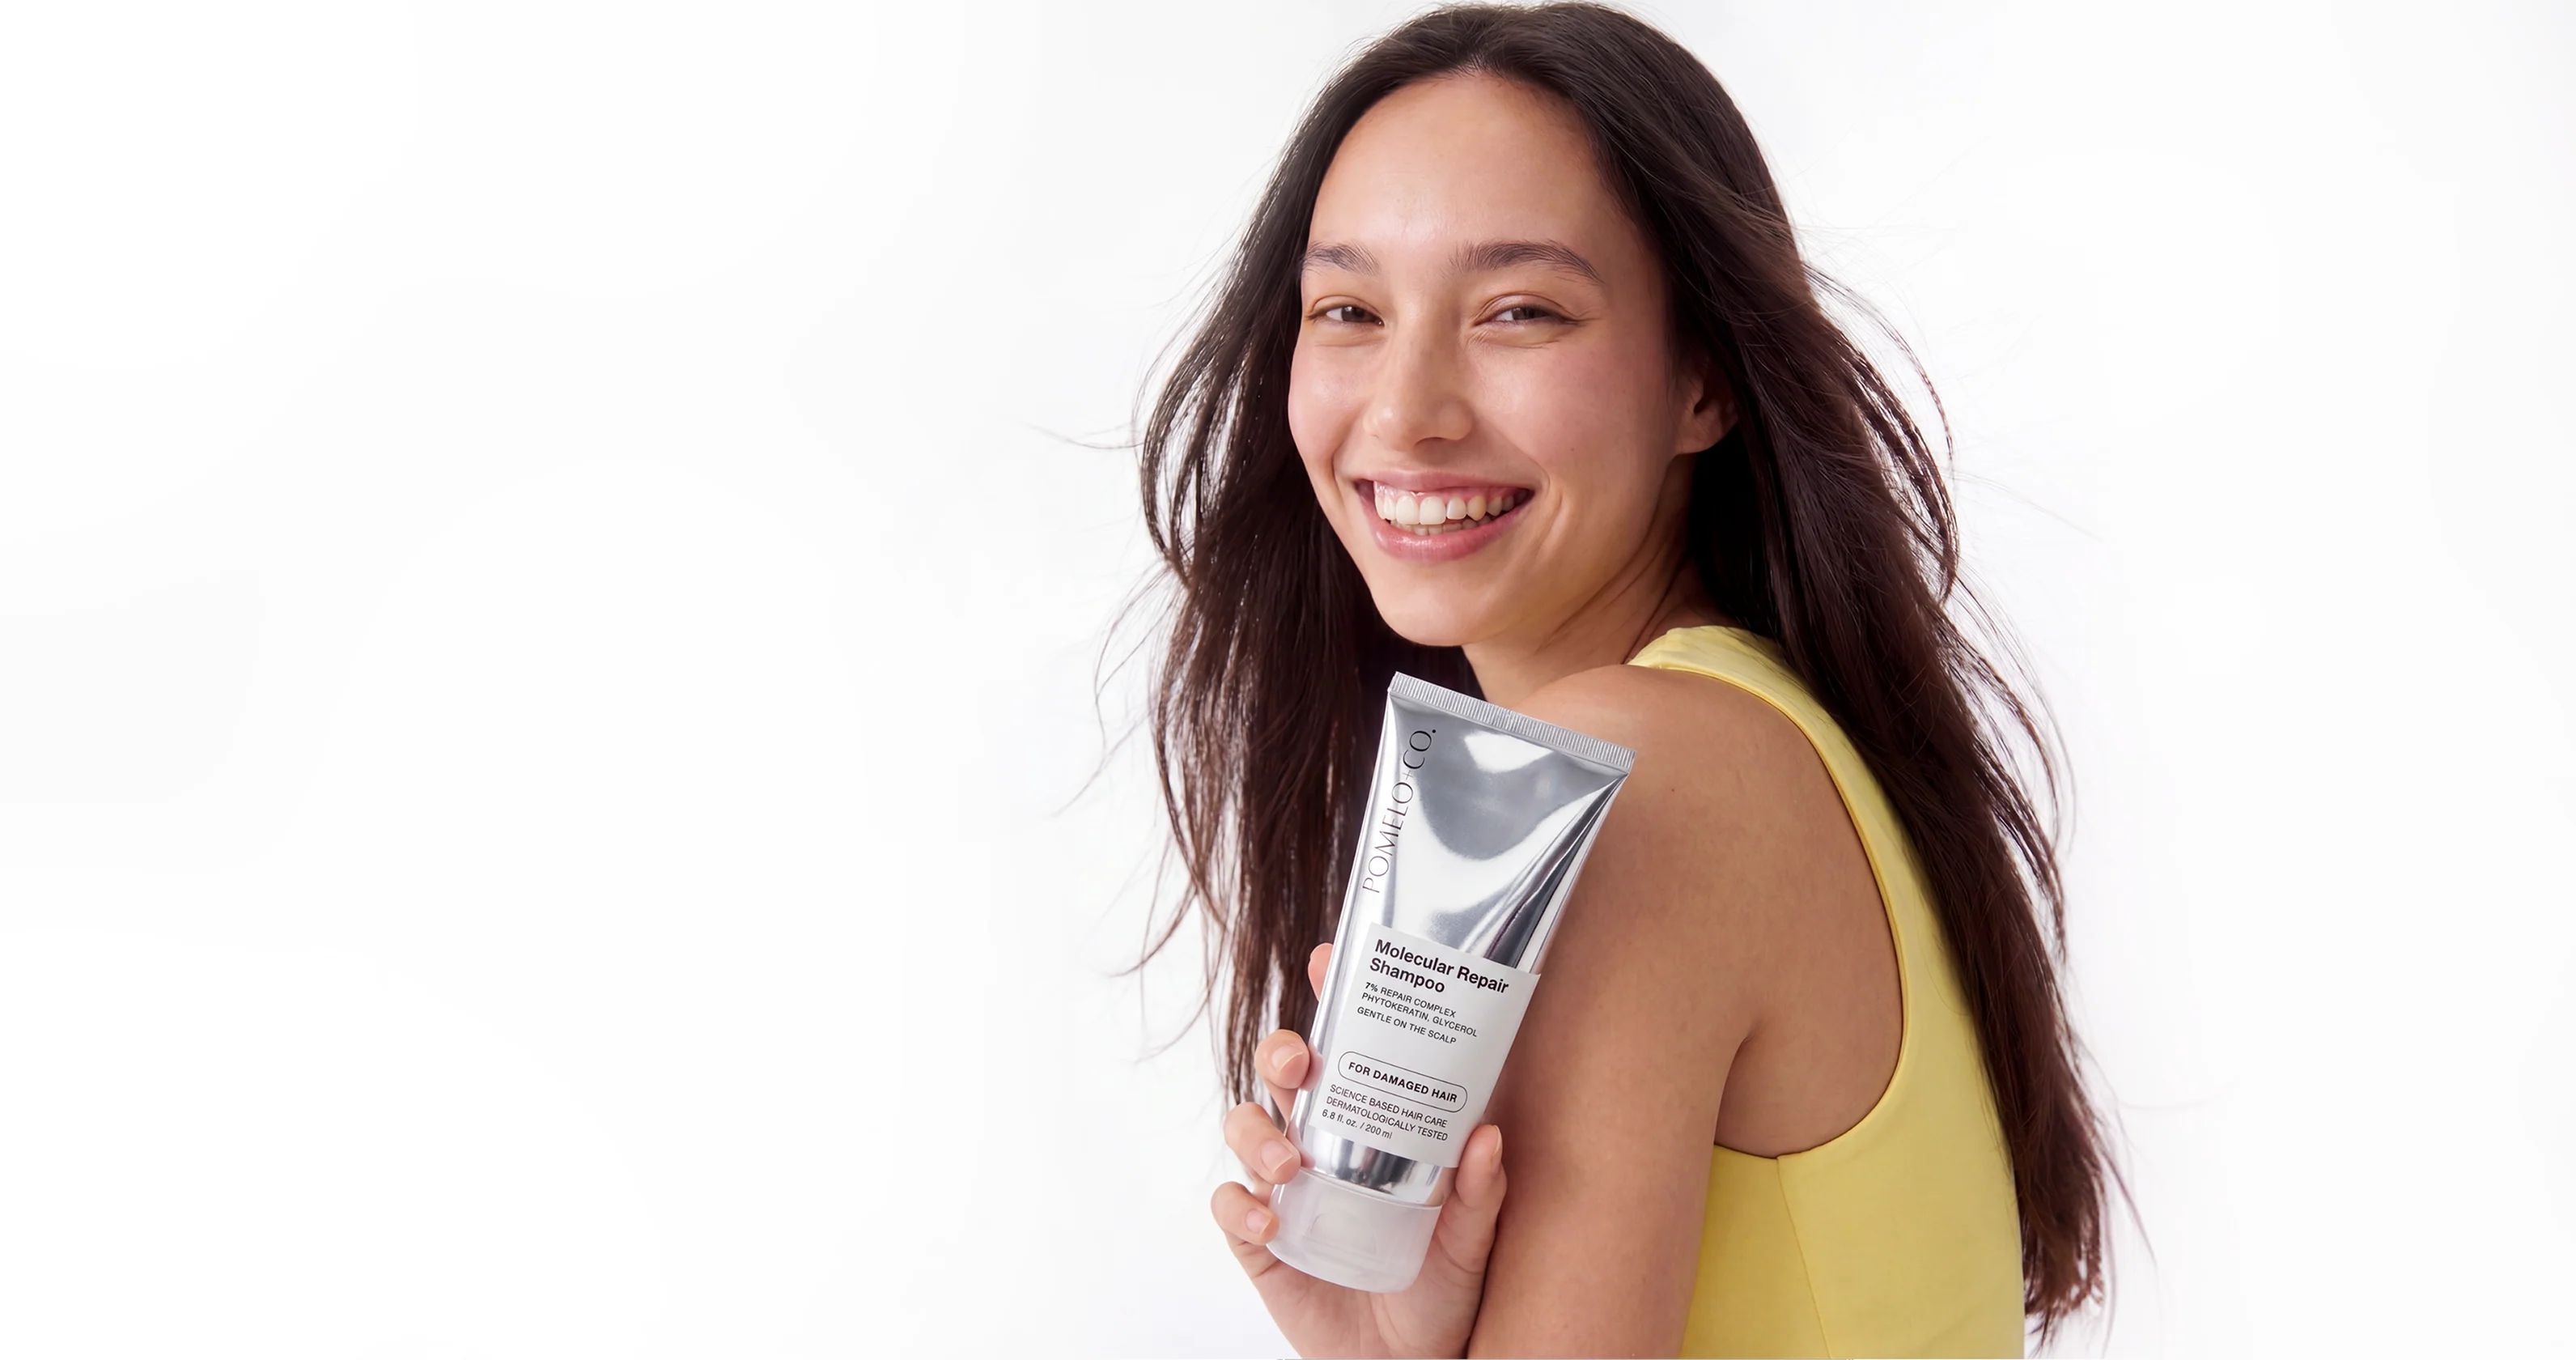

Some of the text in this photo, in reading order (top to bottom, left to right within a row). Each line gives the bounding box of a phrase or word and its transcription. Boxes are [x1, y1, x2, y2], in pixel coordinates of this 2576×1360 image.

[1369, 958, 1445, 992] Shampoo
[1375, 939, 1509, 993] Molecular Repair
[1361, 992, 1478, 1037] PHYTOKERATIN, GLYCEROL
[1364, 982, 1457, 1018] 7% REPAIR COMPLEX
[1356, 1006, 1457, 1045] GENTLE ON THE SCALP
[1348, 1061, 1458, 1103] FOR DAMAGED HAIR
[1322, 1109, 1335, 1120] 6.8
[1346, 1118, 1358, 1128] oz.
[1360, 1121, 1364, 1129] /
[1365, 1124, 1381, 1135] 200
[1381, 1128, 1393, 1139] ml
[1326, 1096, 1448, 1141] DERMATOLOGICALLY TESTED
[1330, 1084, 1448, 1128] SCIENCE BASED HAIR CARE
